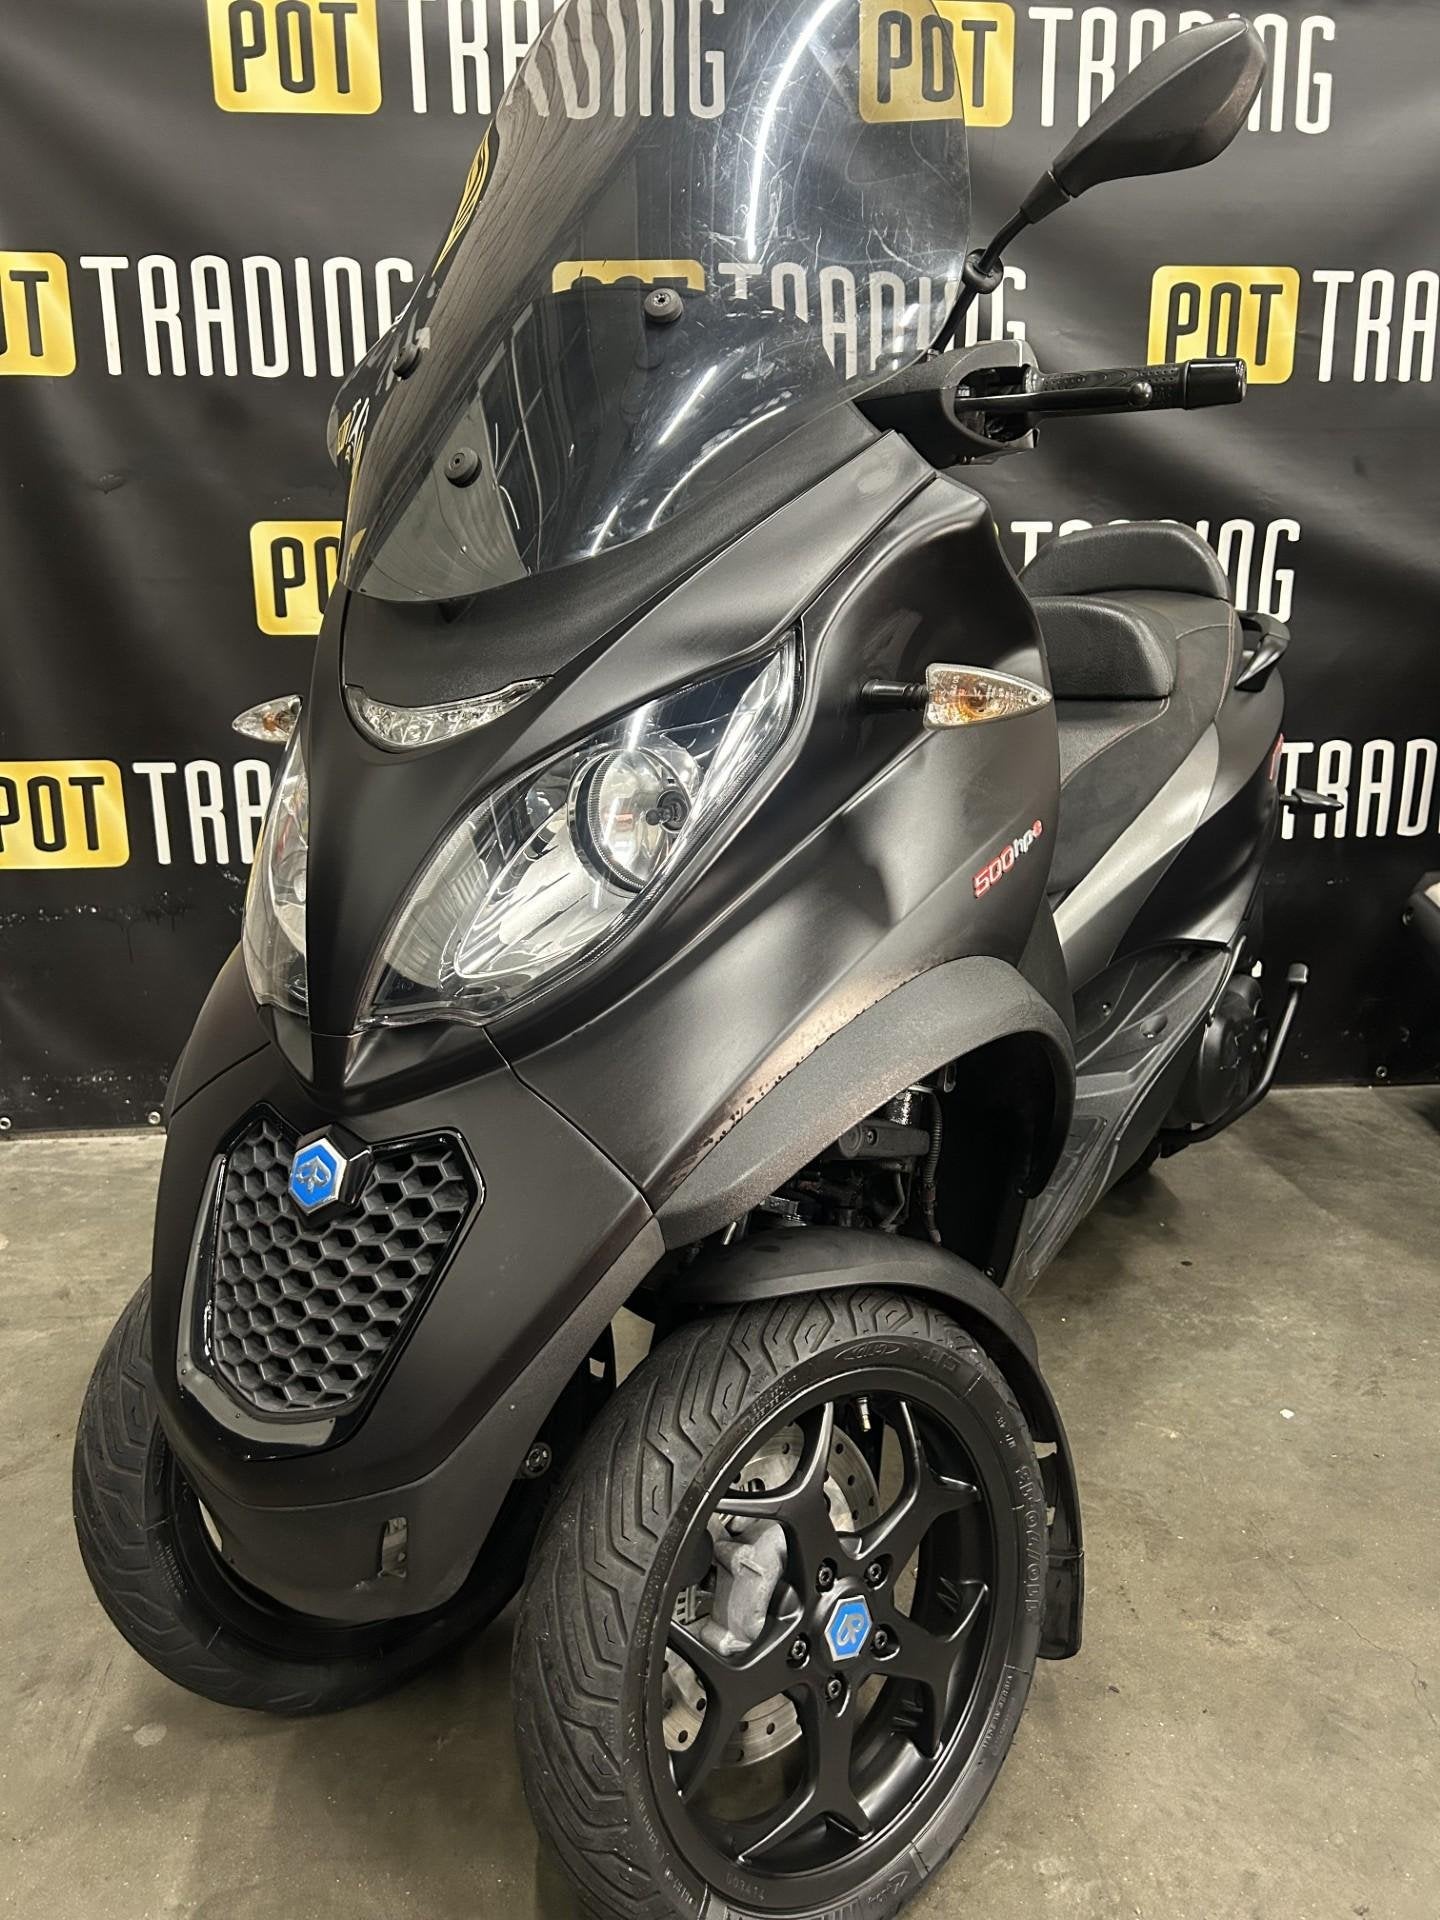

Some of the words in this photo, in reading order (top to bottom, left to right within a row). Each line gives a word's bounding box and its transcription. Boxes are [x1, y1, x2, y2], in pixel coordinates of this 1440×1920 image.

[228, 0, 358, 94] POT
[877, 10, 998, 108] POT
[1164, 281, 1284, 366] POT
[1312, 268, 1440, 383] TRA
